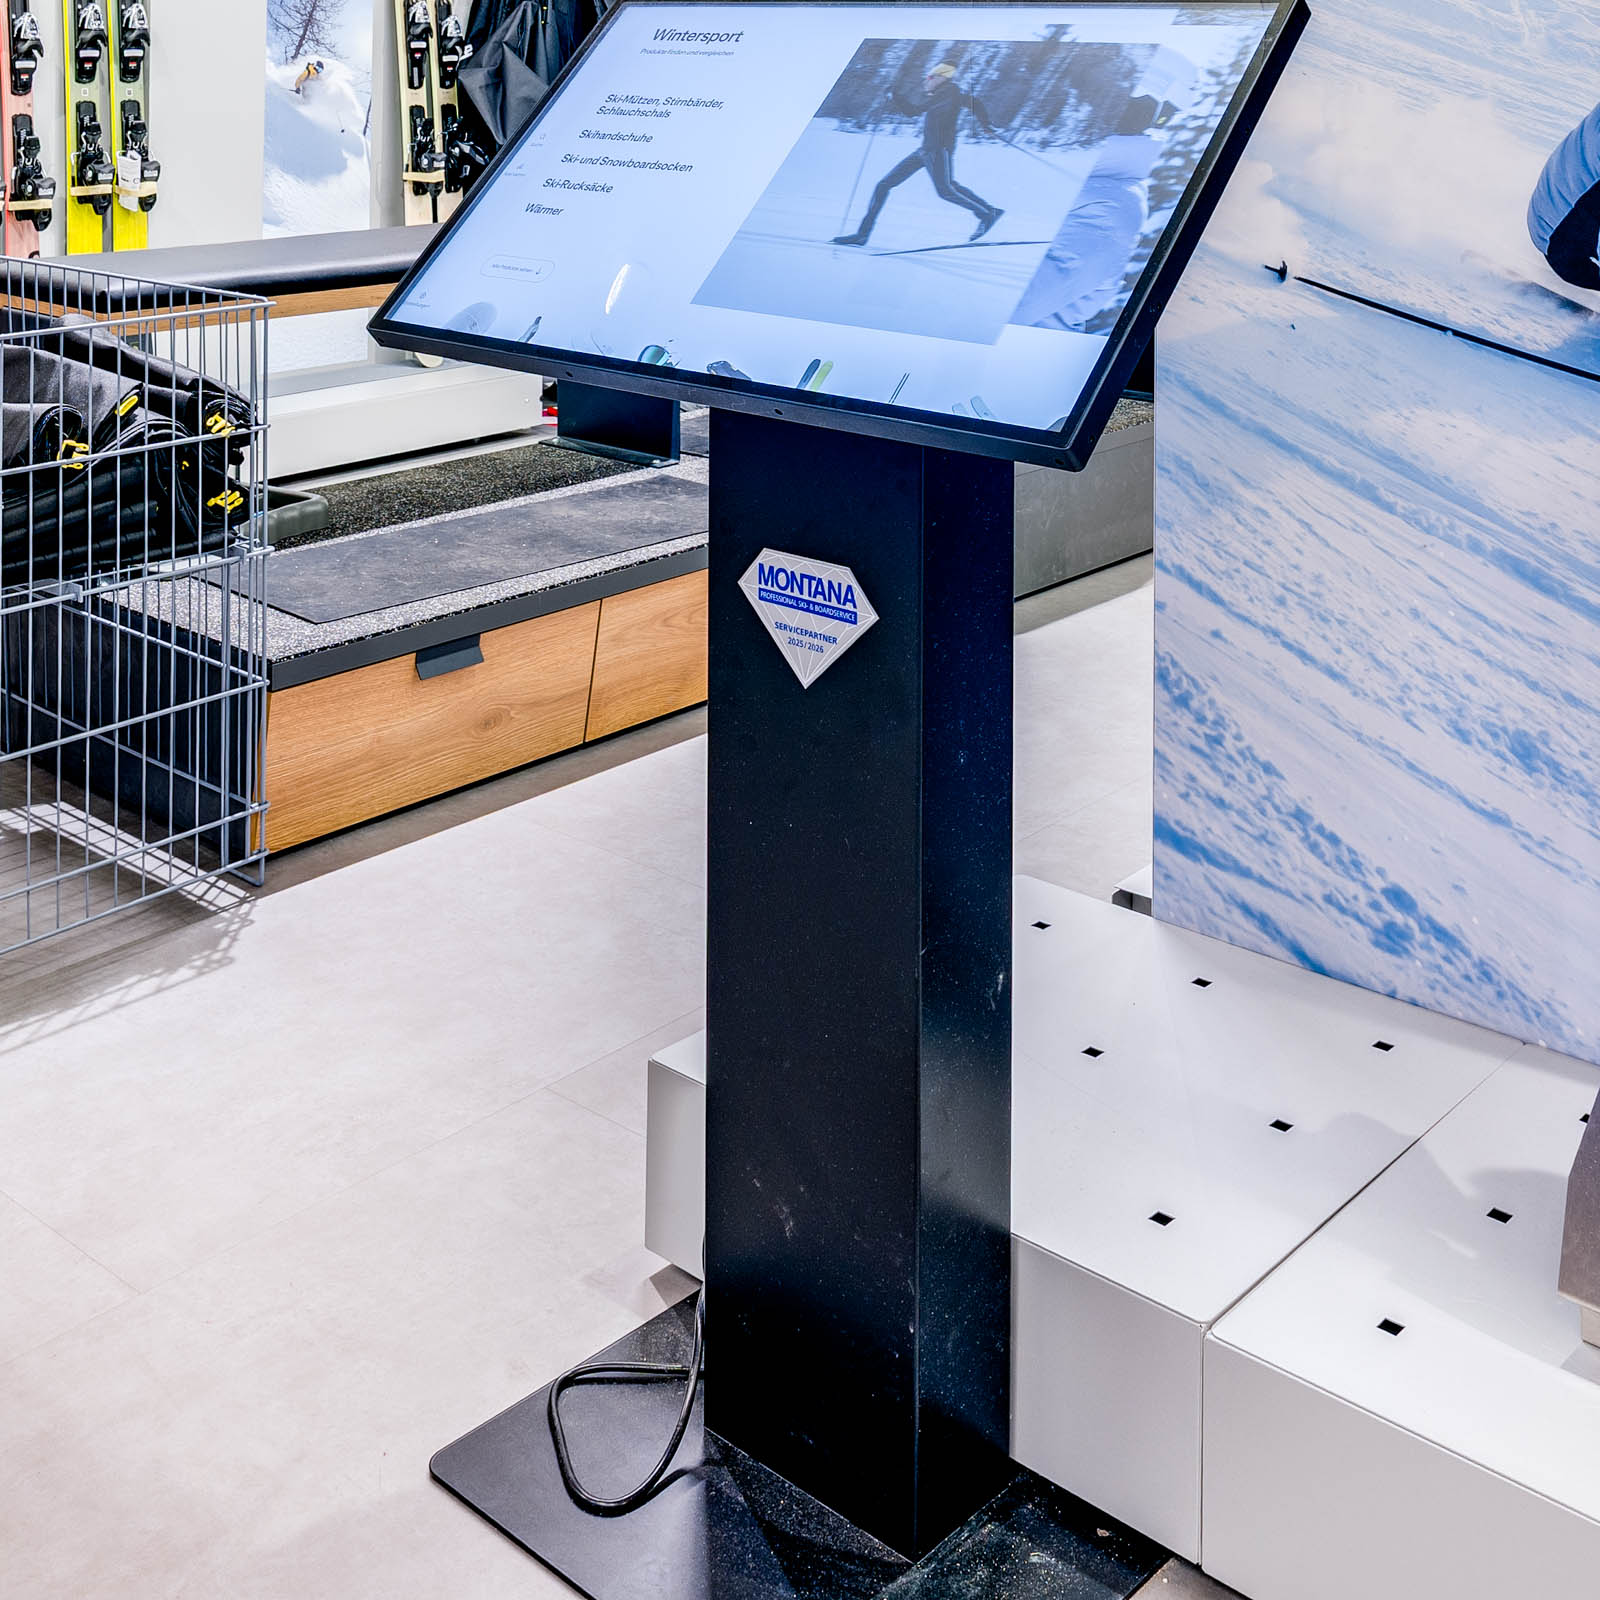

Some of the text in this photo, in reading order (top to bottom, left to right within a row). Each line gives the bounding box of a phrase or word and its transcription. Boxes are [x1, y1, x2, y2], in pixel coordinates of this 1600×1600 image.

[652, 27, 744, 45] Wintersport
[604, 92, 724, 110] Ski-Mützen, Stirnbänder,
[596, 105, 671, 120] Schlauchschals
[578, 129, 654, 144] Skihandschuhe
[599, 157, 693, 173] Snowboardsocken
[542, 178, 614, 194] Ski-Rucksäcke
[525, 202, 564, 217] Wärmer
[758, 563, 857, 609] MONTANA
[760, 590, 797, 607] PROFESSIONAL
[815, 606, 855, 621] BOARDSERVICE
[774, 621, 838, 645] SERVICEPARTNER
